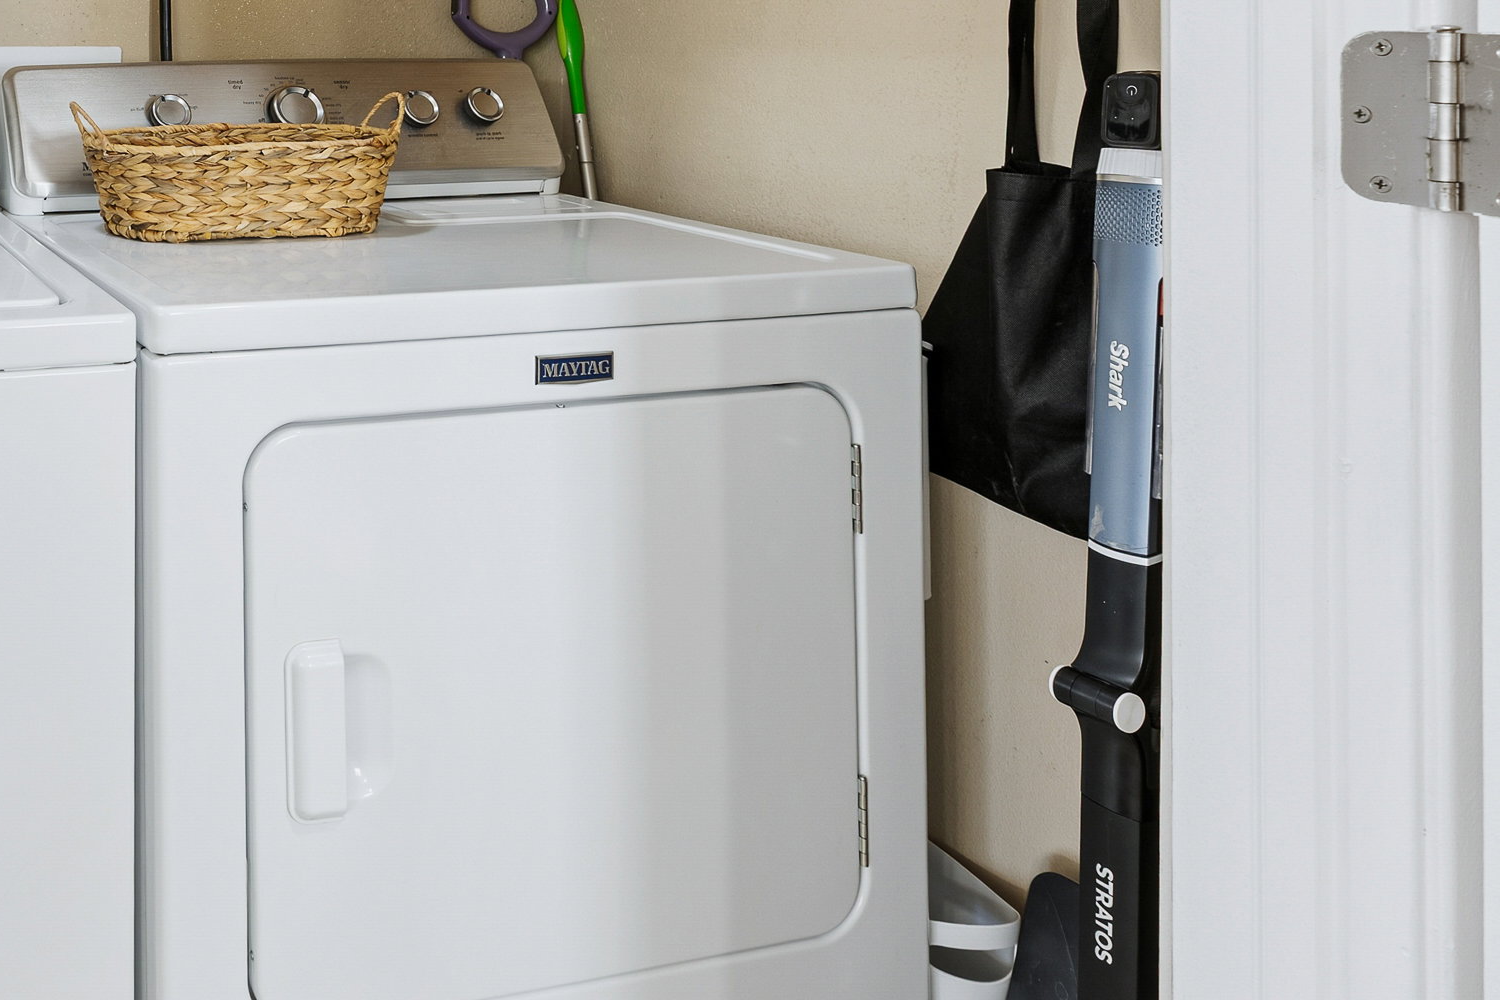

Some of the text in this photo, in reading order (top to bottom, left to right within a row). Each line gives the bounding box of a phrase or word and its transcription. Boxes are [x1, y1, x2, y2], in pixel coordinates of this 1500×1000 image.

[541, 360, 611, 378] MAYTAG
[1108, 340, 1130, 411] Shark
[1094, 863, 1115, 965] STRATOS
